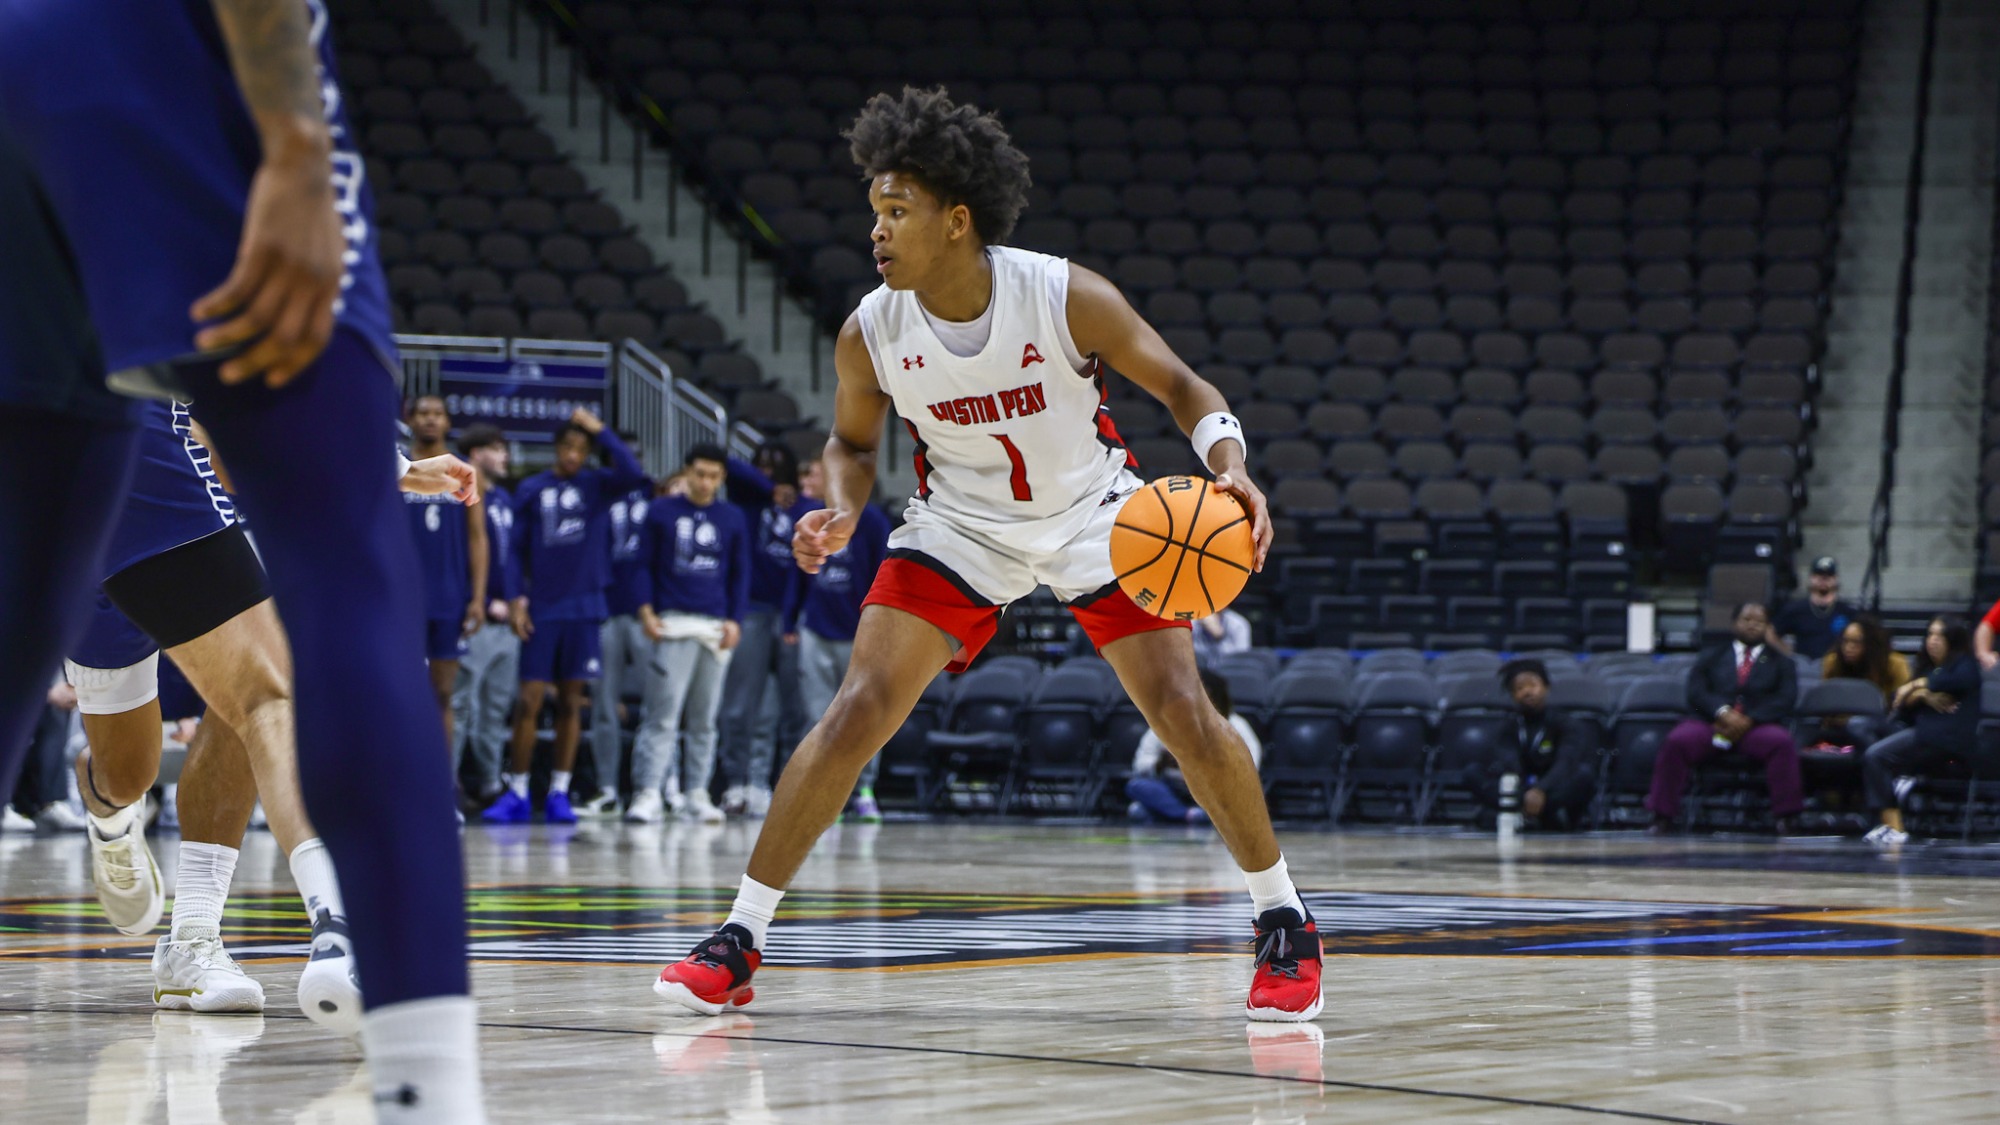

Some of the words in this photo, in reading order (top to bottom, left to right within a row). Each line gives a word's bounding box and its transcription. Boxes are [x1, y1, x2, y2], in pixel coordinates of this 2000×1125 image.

[997, 382, 1047, 419] PEAY
[987, 434, 1033, 501] 1
[424, 503, 441, 532] 6
